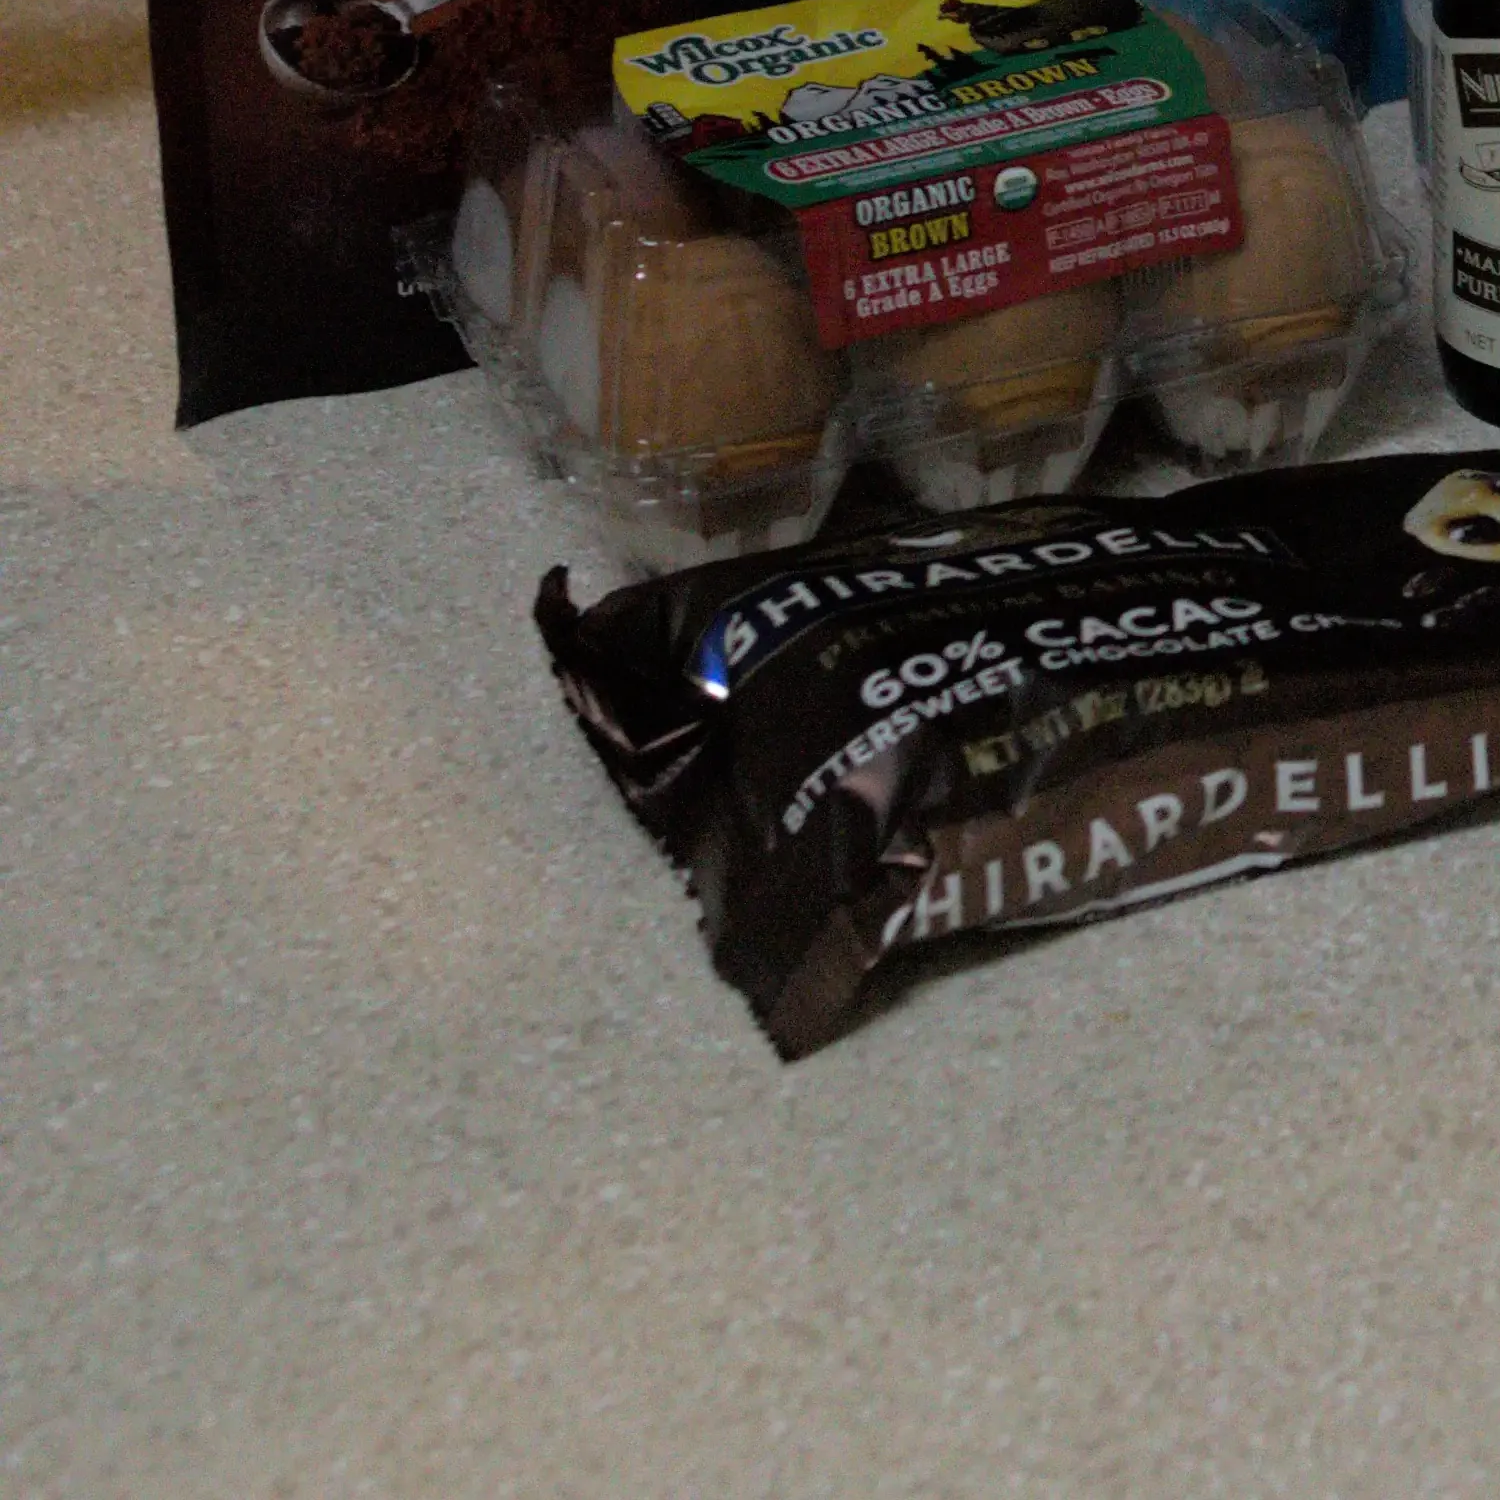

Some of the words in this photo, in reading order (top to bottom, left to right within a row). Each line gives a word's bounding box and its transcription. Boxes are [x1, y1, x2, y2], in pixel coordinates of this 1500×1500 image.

[635, 26, 805, 75] Wilcox
[690, 30, 884, 85] Organic
[766, 93, 947, 145] ORGANIC
[949, 57, 1100, 105] BROWN
[799, 145, 872, 175] EXTRA
[869, 129, 944, 159] LARGE
[940, 116, 1006, 142] Grade
[1003, 109, 1026, 130] A
[1027, 96, 1095, 123] Brown
[1102, 82, 1159, 107] Eggs
[854, 175, 977, 227] ORGANIC
[868, 211, 971, 260] BROWN
[855, 287, 922, 319] Grade
[928, 281, 945, 303] A
[946, 270, 1001, 299] Eggs
[860, 260, 937, 296] EXTRA
[939, 241, 1012, 277] LARGE
[1464, 328, 1496, 351] NET
[858, 628, 1008, 710] 60%
[1023, 595, 1266, 651] CACAO
[780, 655, 1025, 837] BITTERSWEET
[1037, 616, 1283, 673] CHOCOLATE
